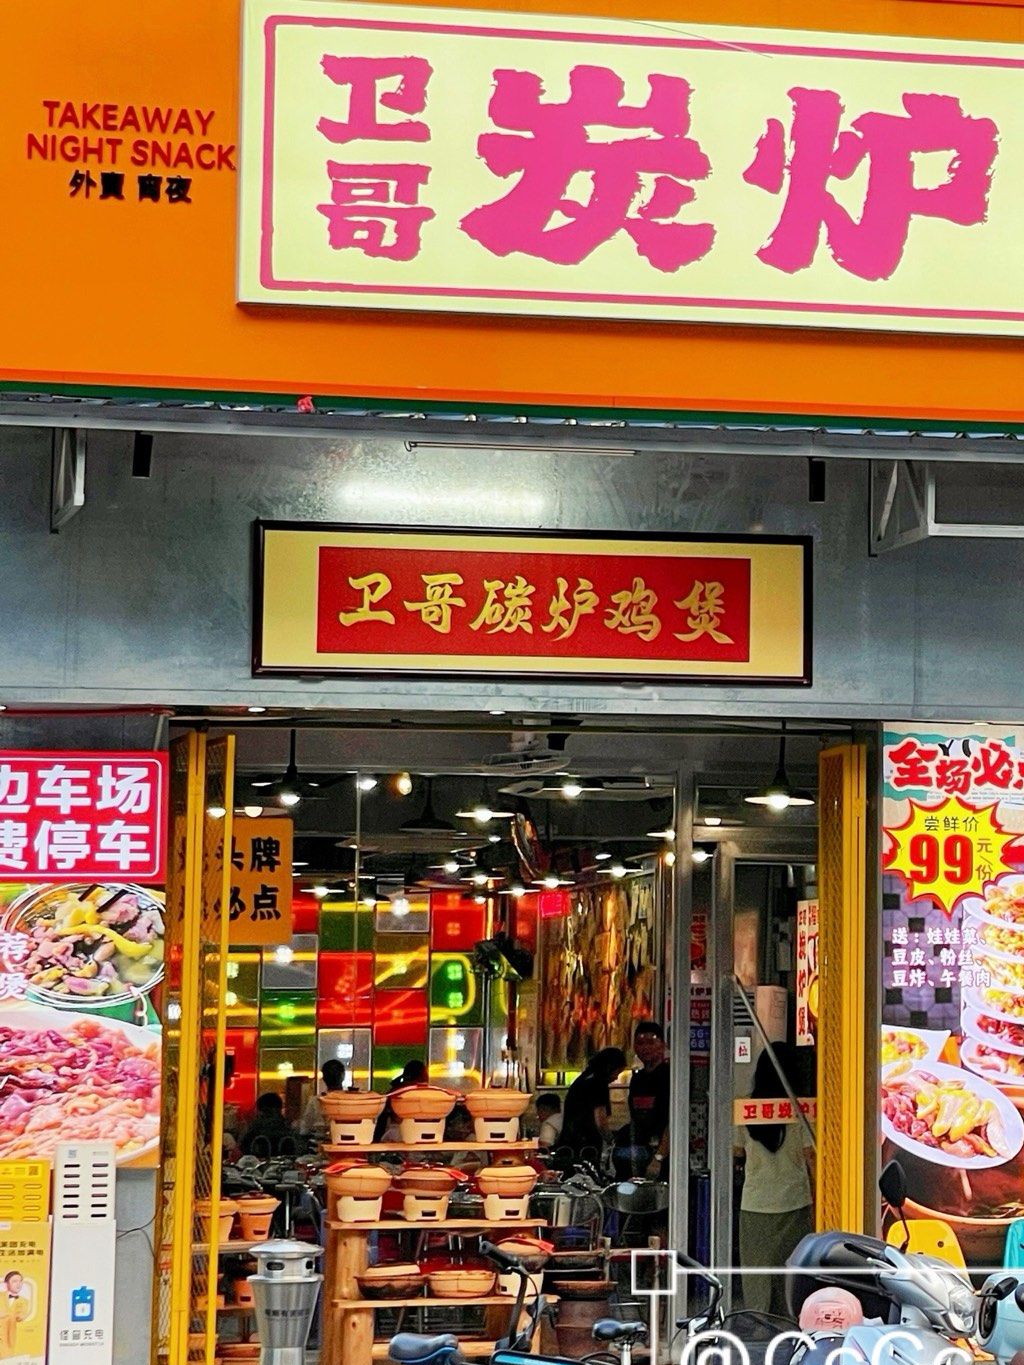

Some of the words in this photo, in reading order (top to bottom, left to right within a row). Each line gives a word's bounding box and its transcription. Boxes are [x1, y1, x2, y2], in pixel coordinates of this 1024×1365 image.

[43, 101, 215, 137] TAKEAWAY
[27, 136, 123, 166] NIGHT
[130, 139, 237, 171] SNACK
[317, 53, 436, 262] 卫哥
[338, 572, 735, 645] 卫哥碳炉鸡煲
[908, 834, 974, 885] 99
